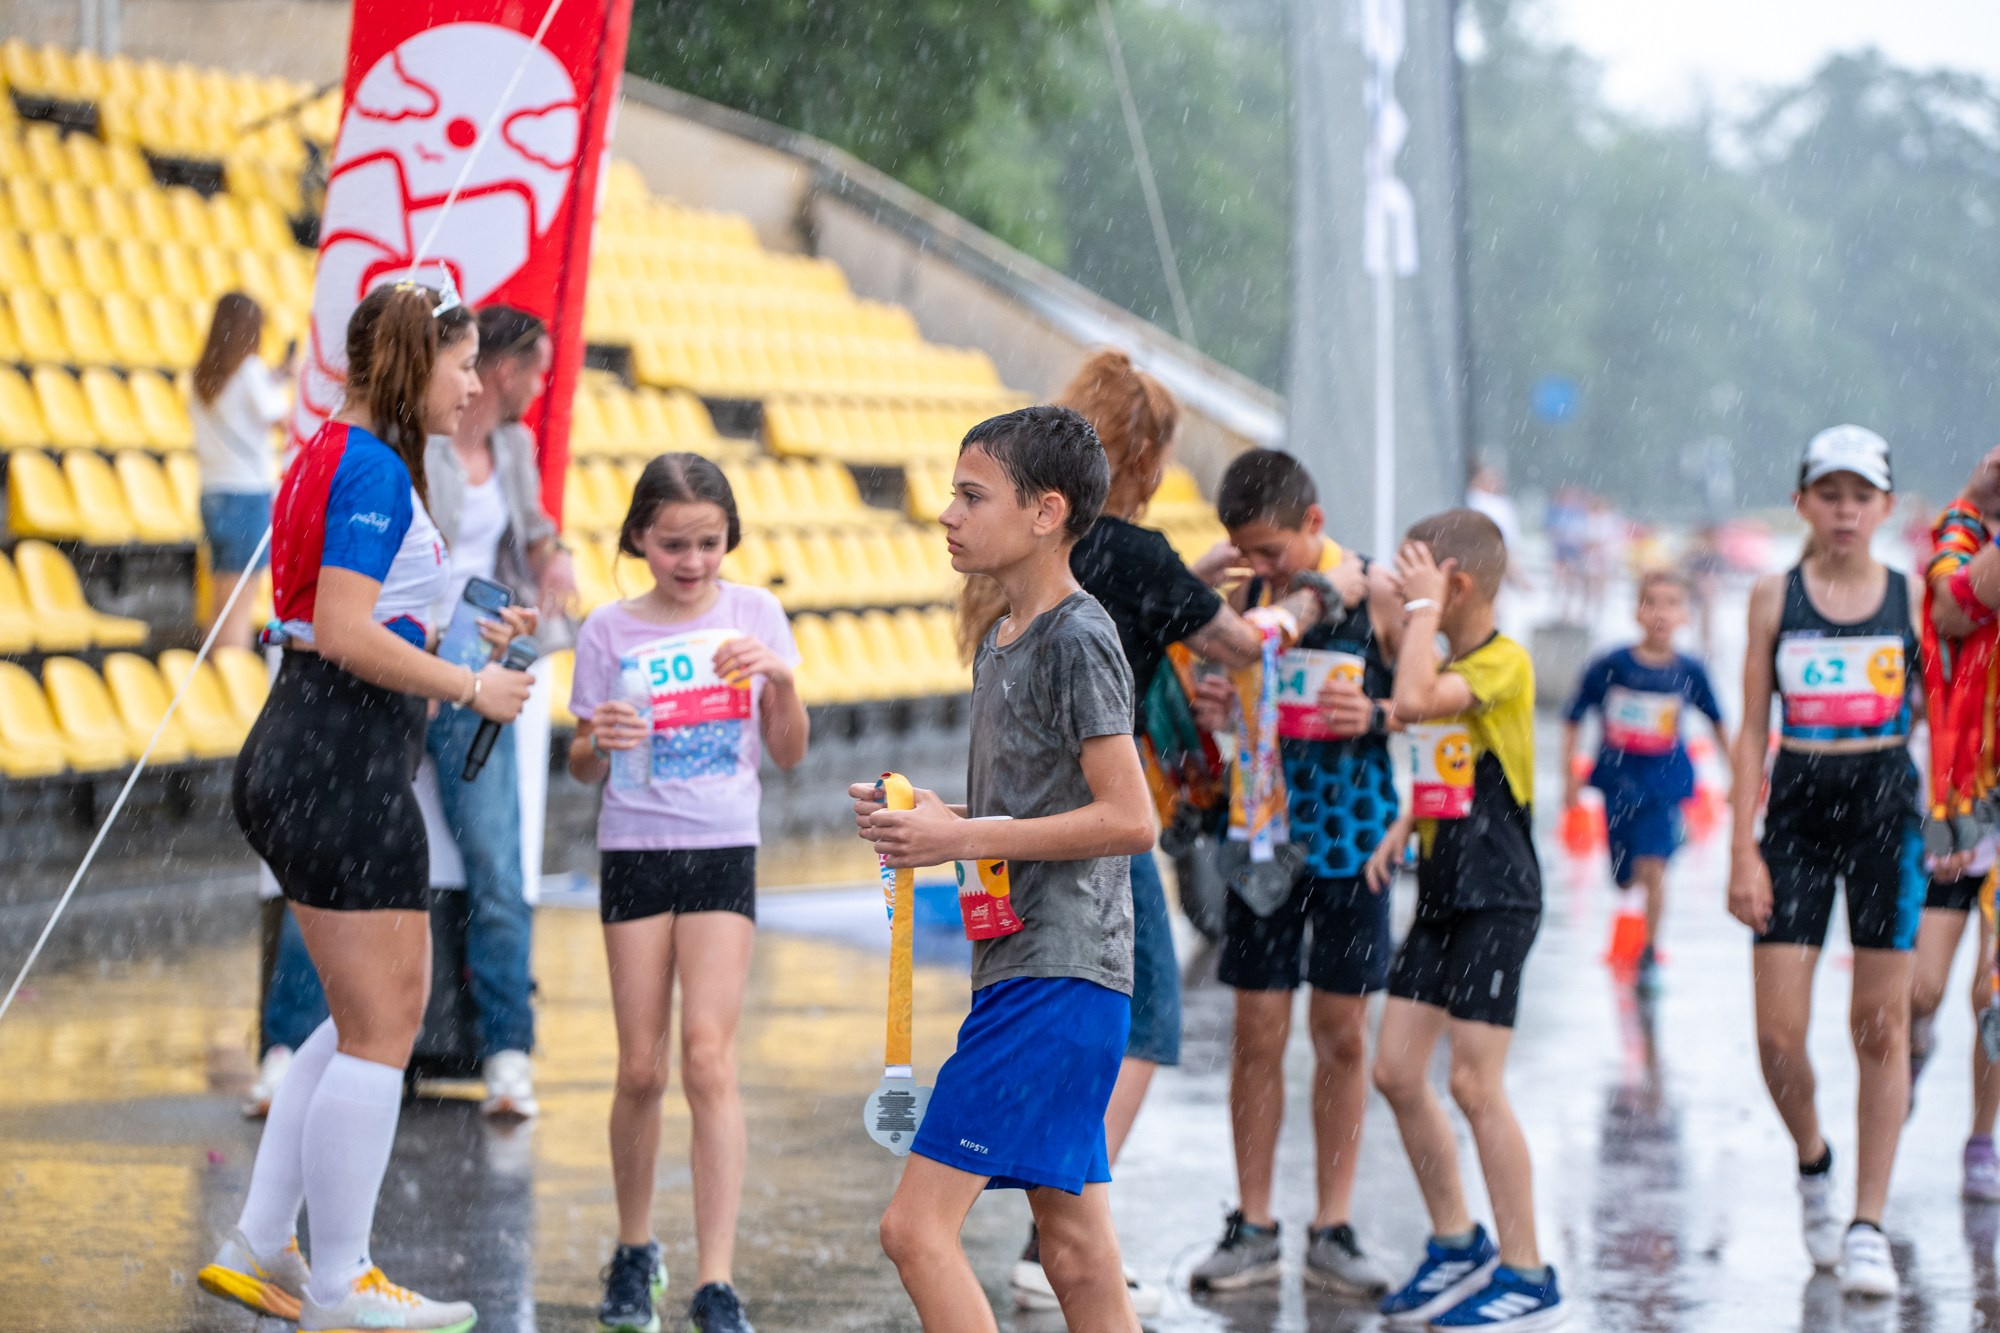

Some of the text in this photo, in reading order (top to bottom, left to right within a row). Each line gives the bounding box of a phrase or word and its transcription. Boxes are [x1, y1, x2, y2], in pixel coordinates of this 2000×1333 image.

[649, 653, 694, 686] 50
[1804, 659, 1844, 686] 62
[960, 1138, 989, 1155] KIPSTA
